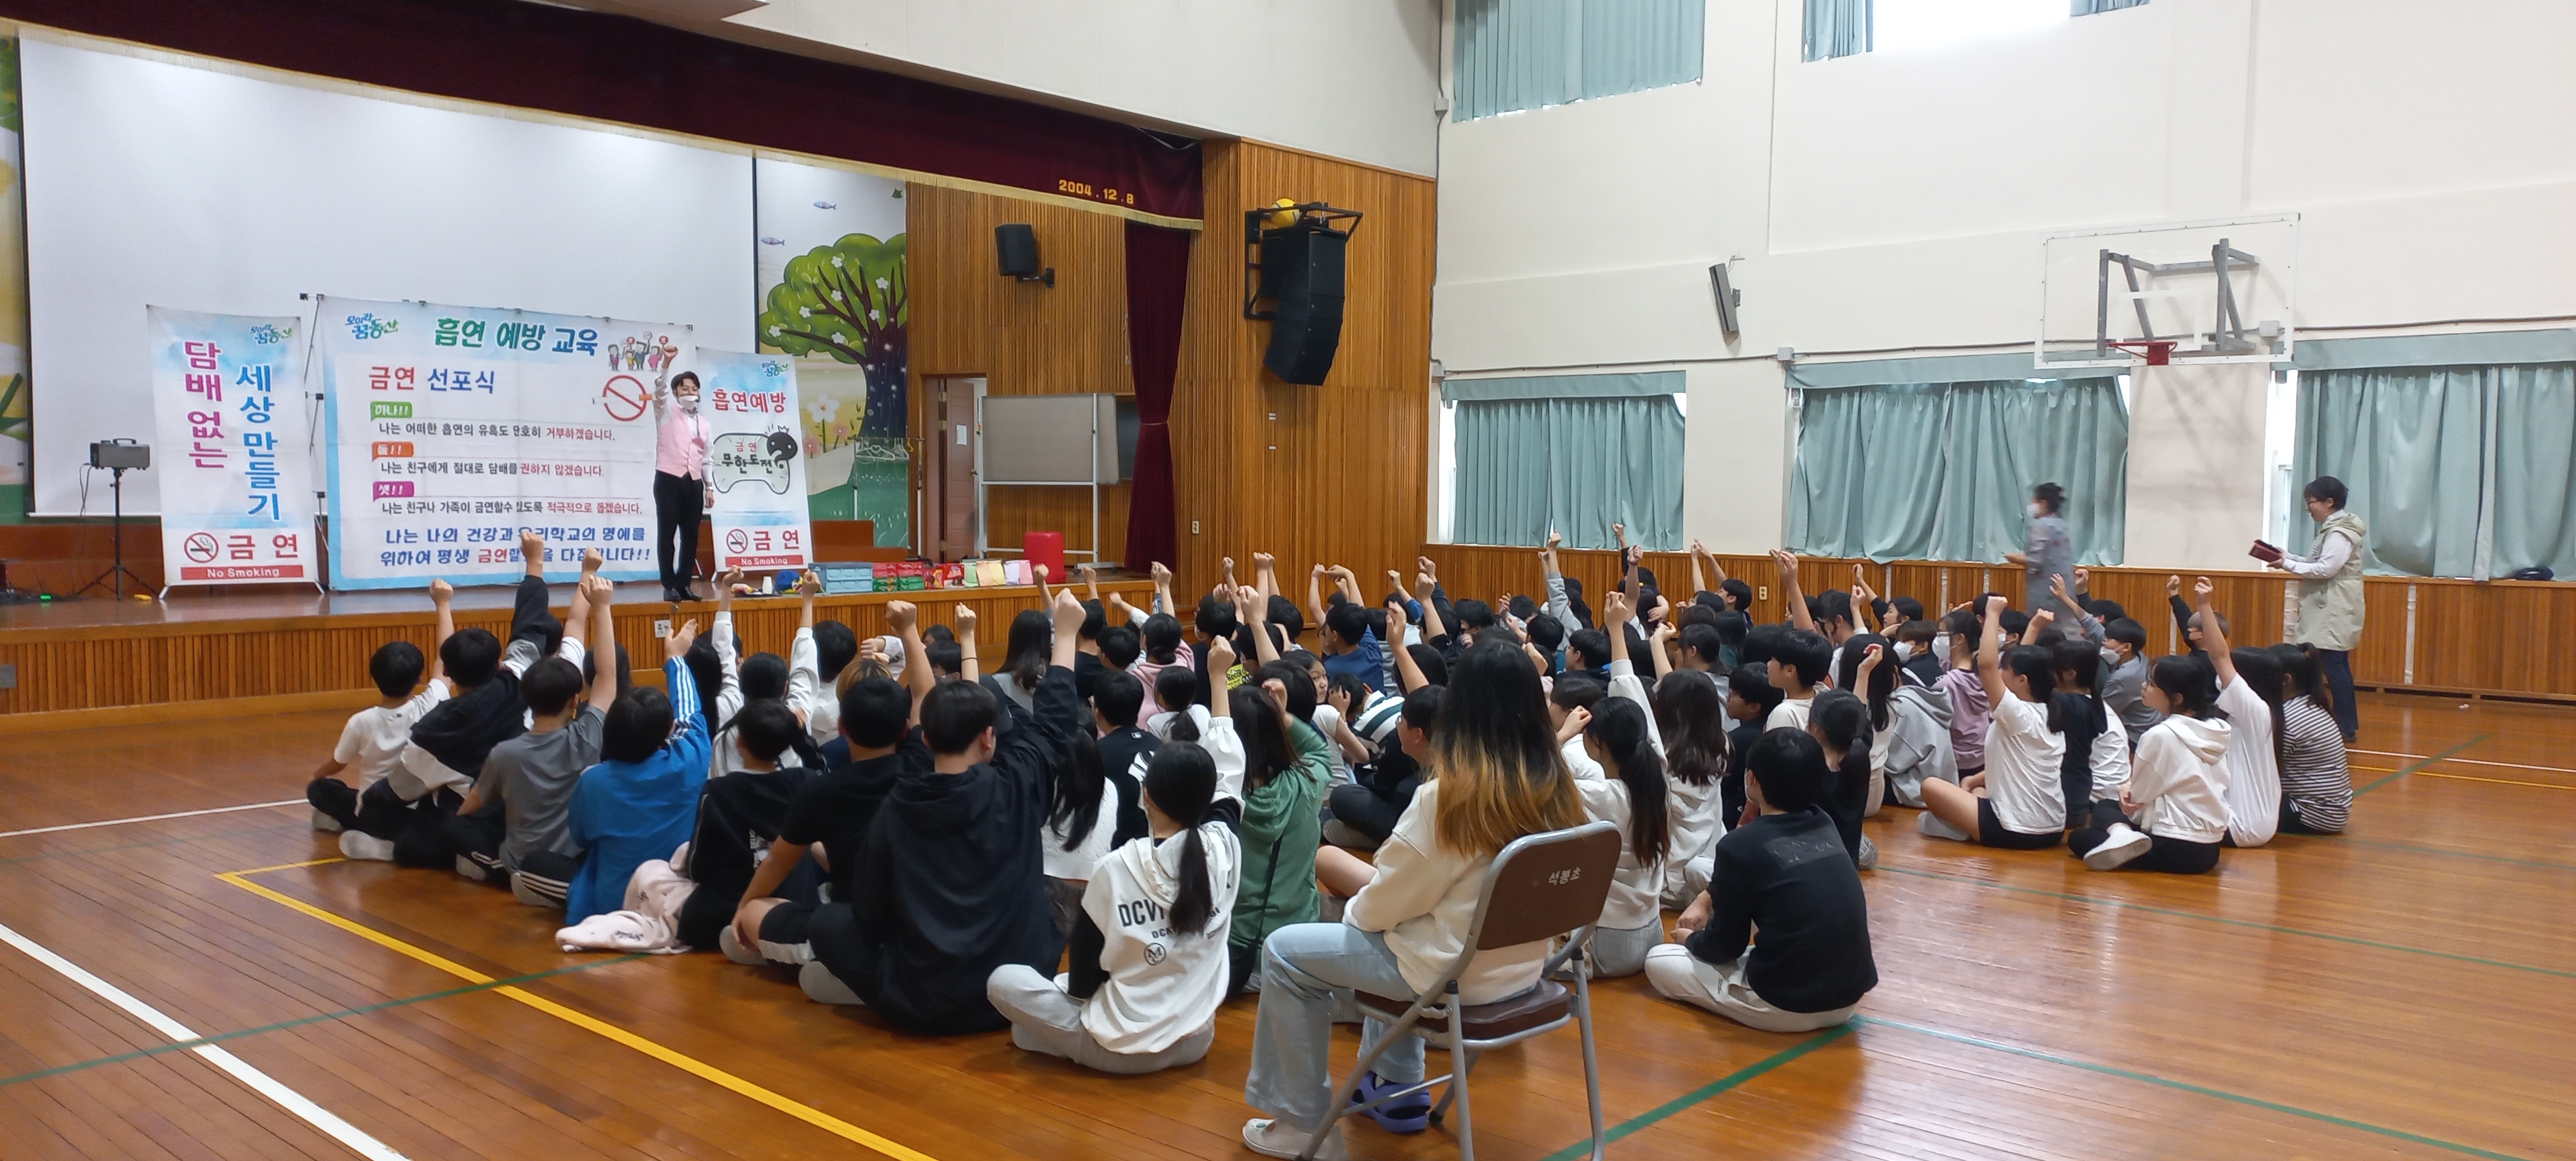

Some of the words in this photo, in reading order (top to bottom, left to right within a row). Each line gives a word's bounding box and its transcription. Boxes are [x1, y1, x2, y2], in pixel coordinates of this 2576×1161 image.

[352, 318, 398, 340] 꿈동산
[435, 318, 486, 348] 흡연
[496, 322, 546, 351] 예방
[552, 328, 598, 357] 교육
[184, 341, 223, 402] 담배
[369, 366, 414, 391] 금연
[427, 368, 495, 394] 선포식
[236, 365, 275, 424] 세상
[711, 388, 787, 414] 흡연예방
[187, 411, 228, 468] 없는
[379, 422, 401, 435] 나는
[406, 422, 437, 435] 어떠한
[442, 422, 473, 436] 흡연의
[478, 424, 509, 437] 유혹도
[513, 425, 540, 438] 단호히
[546, 427, 616, 440] 거부하겠습니다.
[381, 461, 402, 474] 나는
[407, 461, 448, 474] 친구에게
[453, 462, 484, 474] 절대로
[489, 462, 517, 474] 담배를
[520, 463, 550, 475] 권하지
[555, 464, 604, 477] 않겠습니다.
[721, 452, 773, 475] 무한도전
[243, 431, 280, 521] 만들기
[378, 484, 403, 496] 셋!!
[382, 502, 402, 514] 나는
[407, 501, 435, 514] 친구나
[440, 501, 470, 514] 가족이
[475, 501, 513, 514] 금연할수
[516, 501, 543, 513] 있도록
[548, 502, 592, 514] 적극적으로
[597, 502, 642, 514] 돕겠습니다.
[386, 529, 418, 544] 나는
[427, 528, 458, 543] 나의
[467, 527, 513, 542] 건강과
[602, 527, 645, 542] 명예를
[380, 550, 431, 566] 위하여
[437, 549, 470, 564] 평생
[753, 557, 788, 565] Smoking
[207, 568, 224, 578] No
[227, 567, 280, 578] Smoking
[1548, 867, 1582, 886] 석봉초
